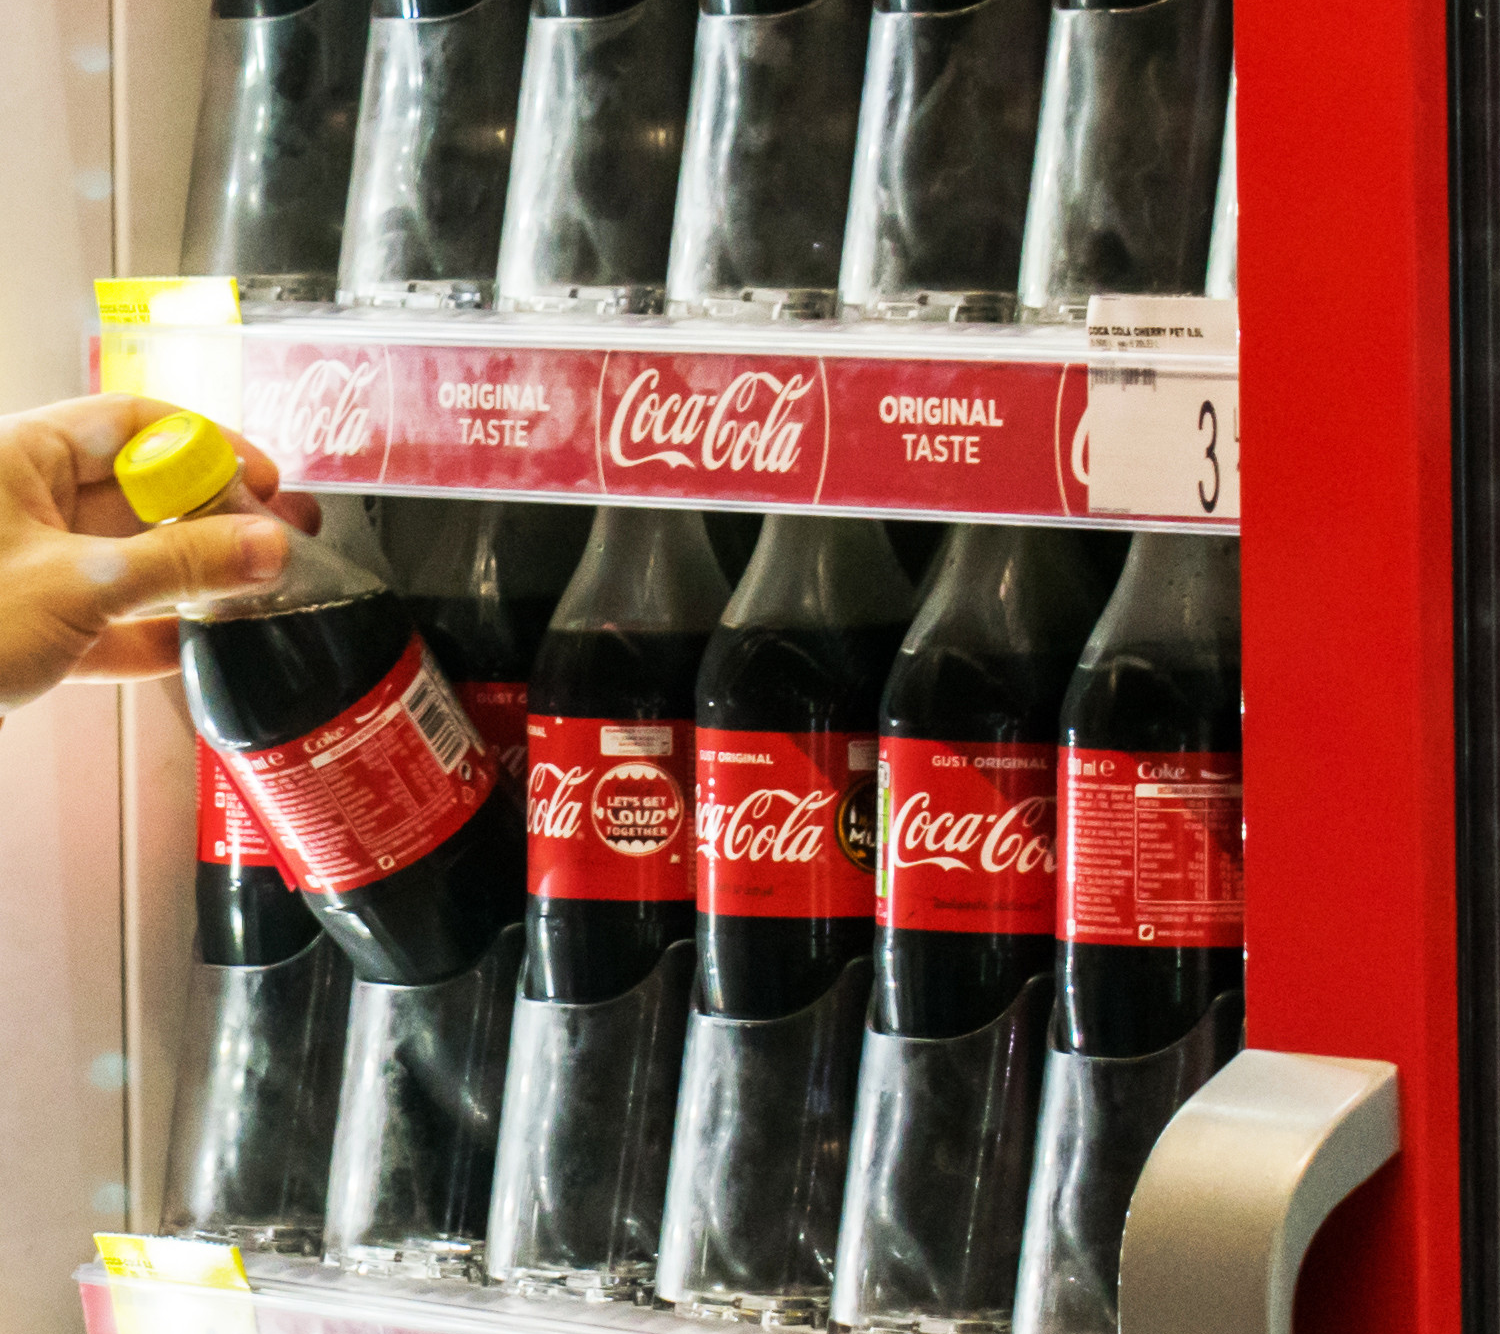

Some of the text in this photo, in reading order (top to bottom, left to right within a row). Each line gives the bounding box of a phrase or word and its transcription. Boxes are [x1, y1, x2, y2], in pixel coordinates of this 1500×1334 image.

[1088, 326, 1109, 336] COCA
[1112, 326, 1132, 337] COLA
[1134, 327, 1167, 337] CHERRY
[437, 380, 550, 413] ORIGINAL
[609, 368, 817, 474] Coca-Cola
[879, 395, 1004, 428] ORIGINAL
[459, 418, 530, 448] TASTE
[902, 433, 982, 464] TASTE
[1199, 399, 1220, 514] 3
[718, 750, 774, 766] ORIGINAL
[931, 755, 1048, 770] GUST ORIGINAL
[1137, 762, 1188, 780] Coke
[606, 796, 668, 807] LET'S GET
[606, 809, 668, 826] LOUD
[606, 826, 668, 837] TOGETHER
[893, 791, 1058, 874] Coca-Co
